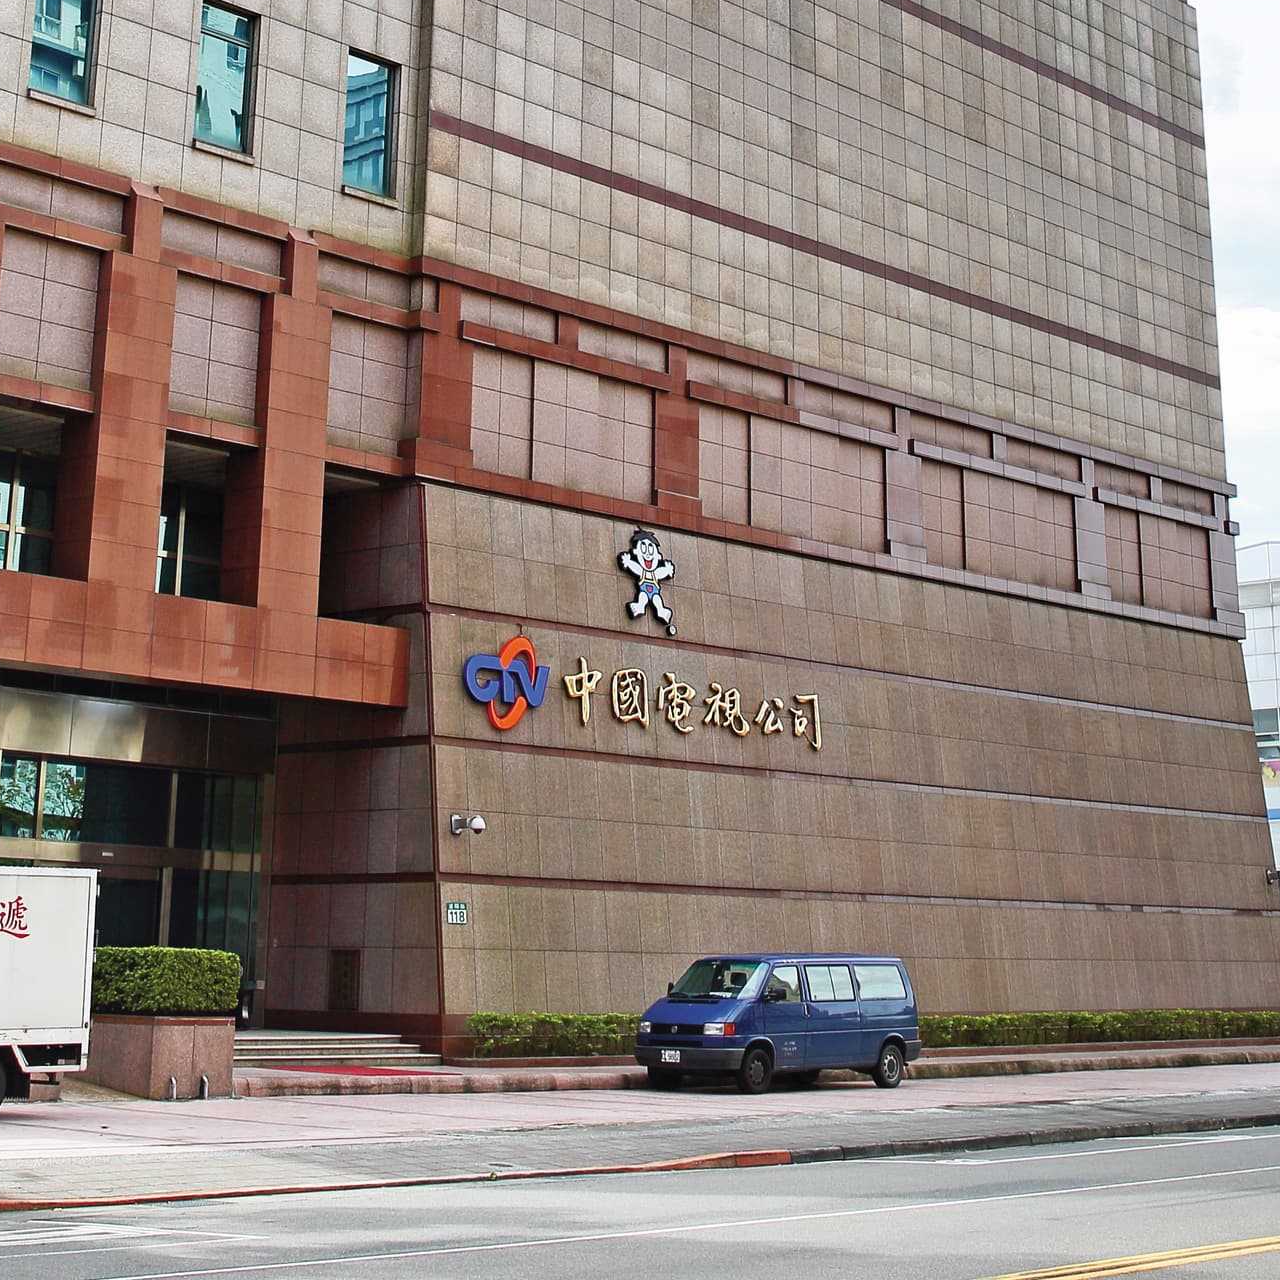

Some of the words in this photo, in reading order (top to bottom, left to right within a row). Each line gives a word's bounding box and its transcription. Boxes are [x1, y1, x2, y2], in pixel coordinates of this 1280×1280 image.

[463, 652, 551, 709] CTV
[563, 656, 822, 751] 中國電視公司
[449, 911, 465, 923] 118
